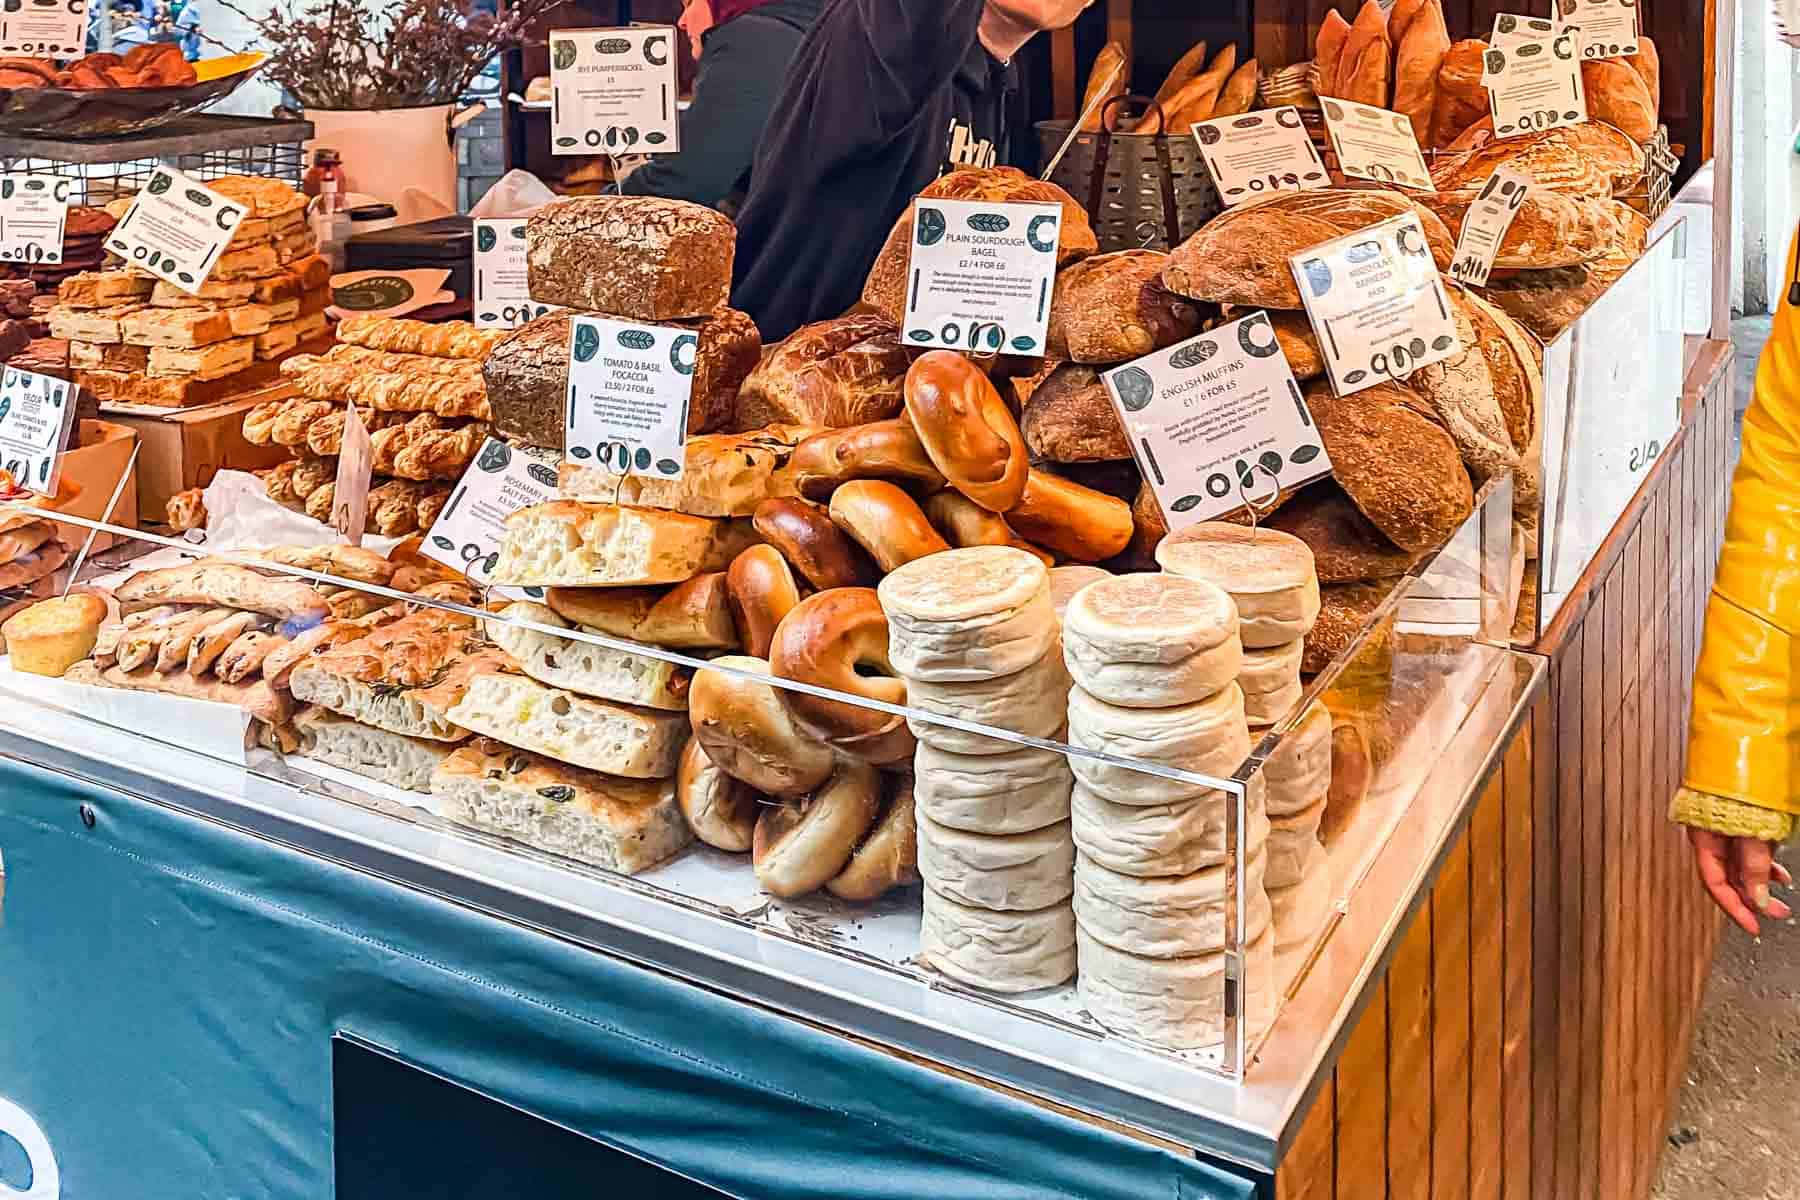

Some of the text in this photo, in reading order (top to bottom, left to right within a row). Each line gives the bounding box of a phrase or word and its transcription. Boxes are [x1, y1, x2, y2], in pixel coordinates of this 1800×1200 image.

[945, 233, 1025, 247] PLAIN SOURDOUGH
[971, 248, 998, 257] BAGEL
[980, 261, 994, 269] FOR
[603, 357, 633, 369] TOMATO
[641, 361, 662, 373] BASIL
[611, 370, 649, 382] FOCACCIA
[1161, 359, 1244, 400] ENGLISH MUFFINS
[1206, 385, 1225, 398] FOR
